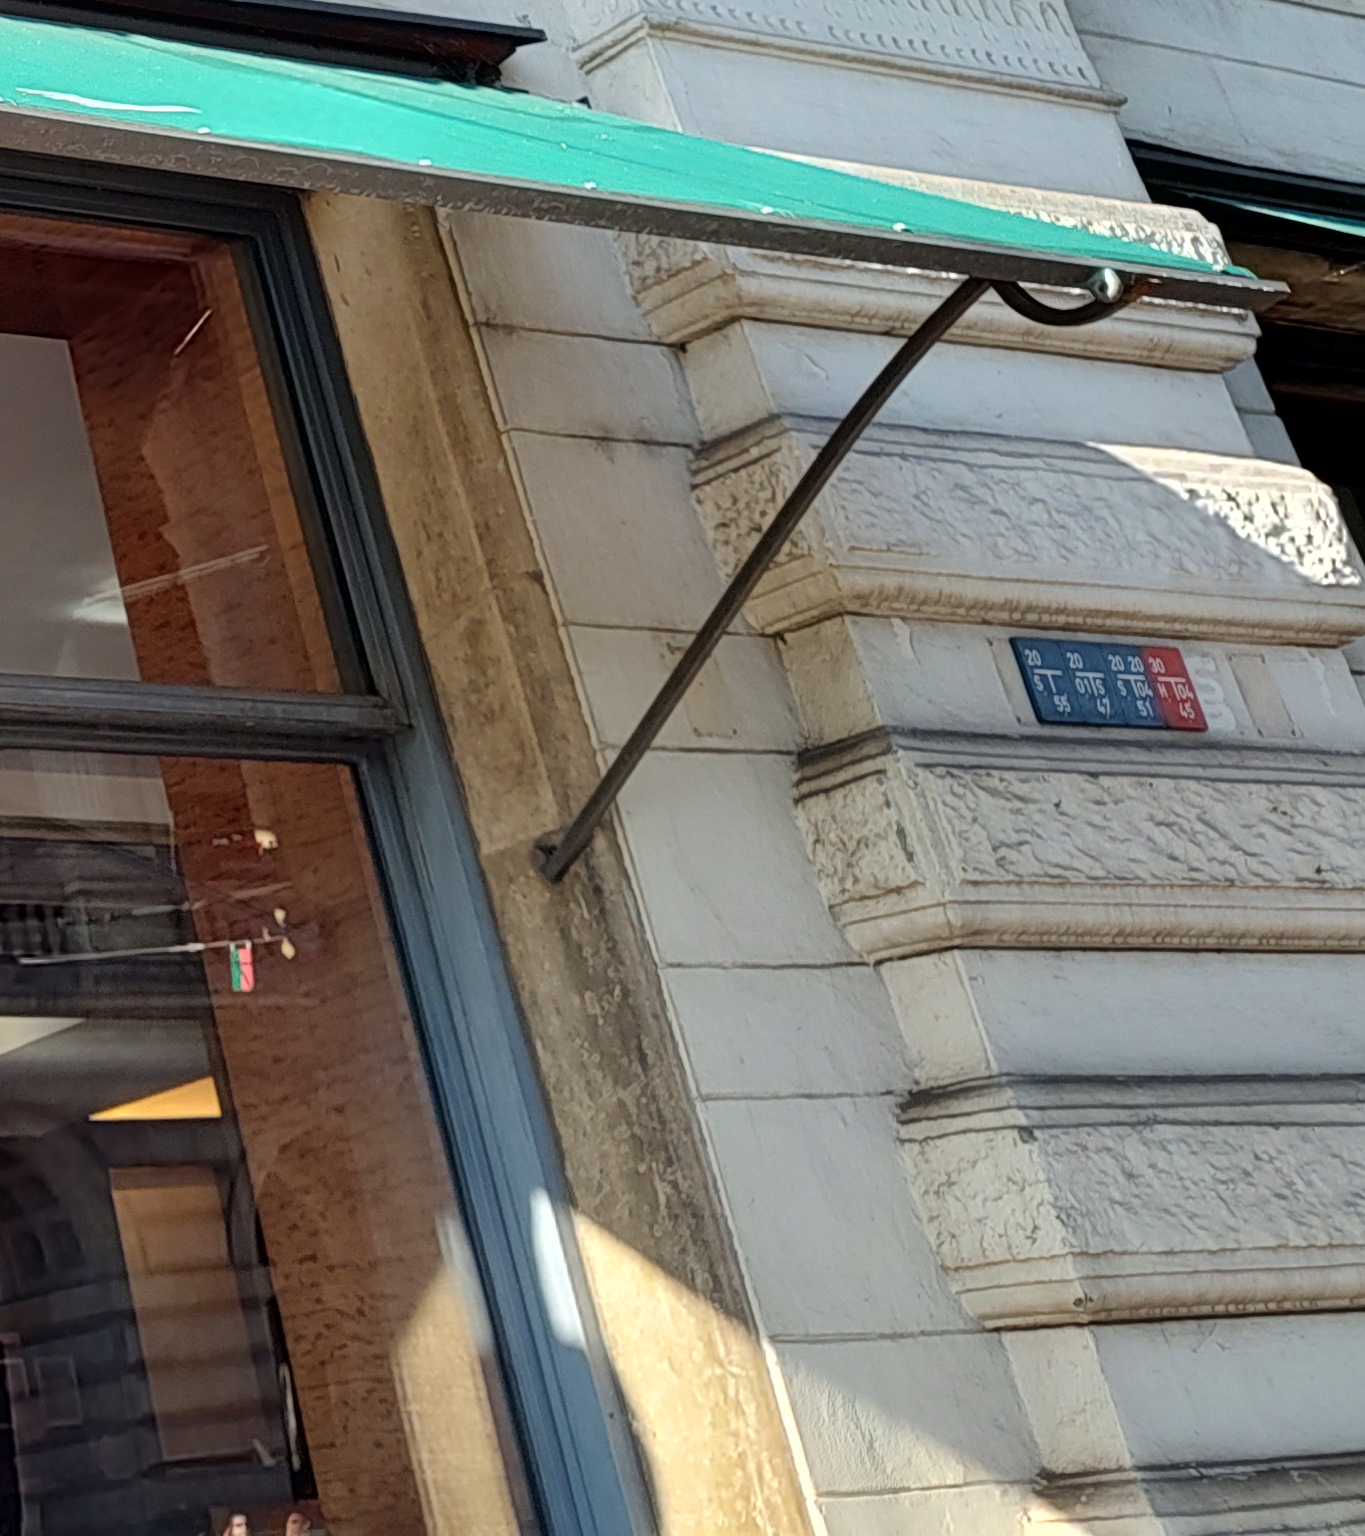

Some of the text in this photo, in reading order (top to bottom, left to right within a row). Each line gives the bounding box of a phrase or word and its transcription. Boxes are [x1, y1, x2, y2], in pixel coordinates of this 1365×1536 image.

[1024, 648, 1042, 666] 20
[1066, 651, 1084, 669] 20
[1108, 654, 1145, 673] 20 20
[1148, 657, 1166, 674] 30
